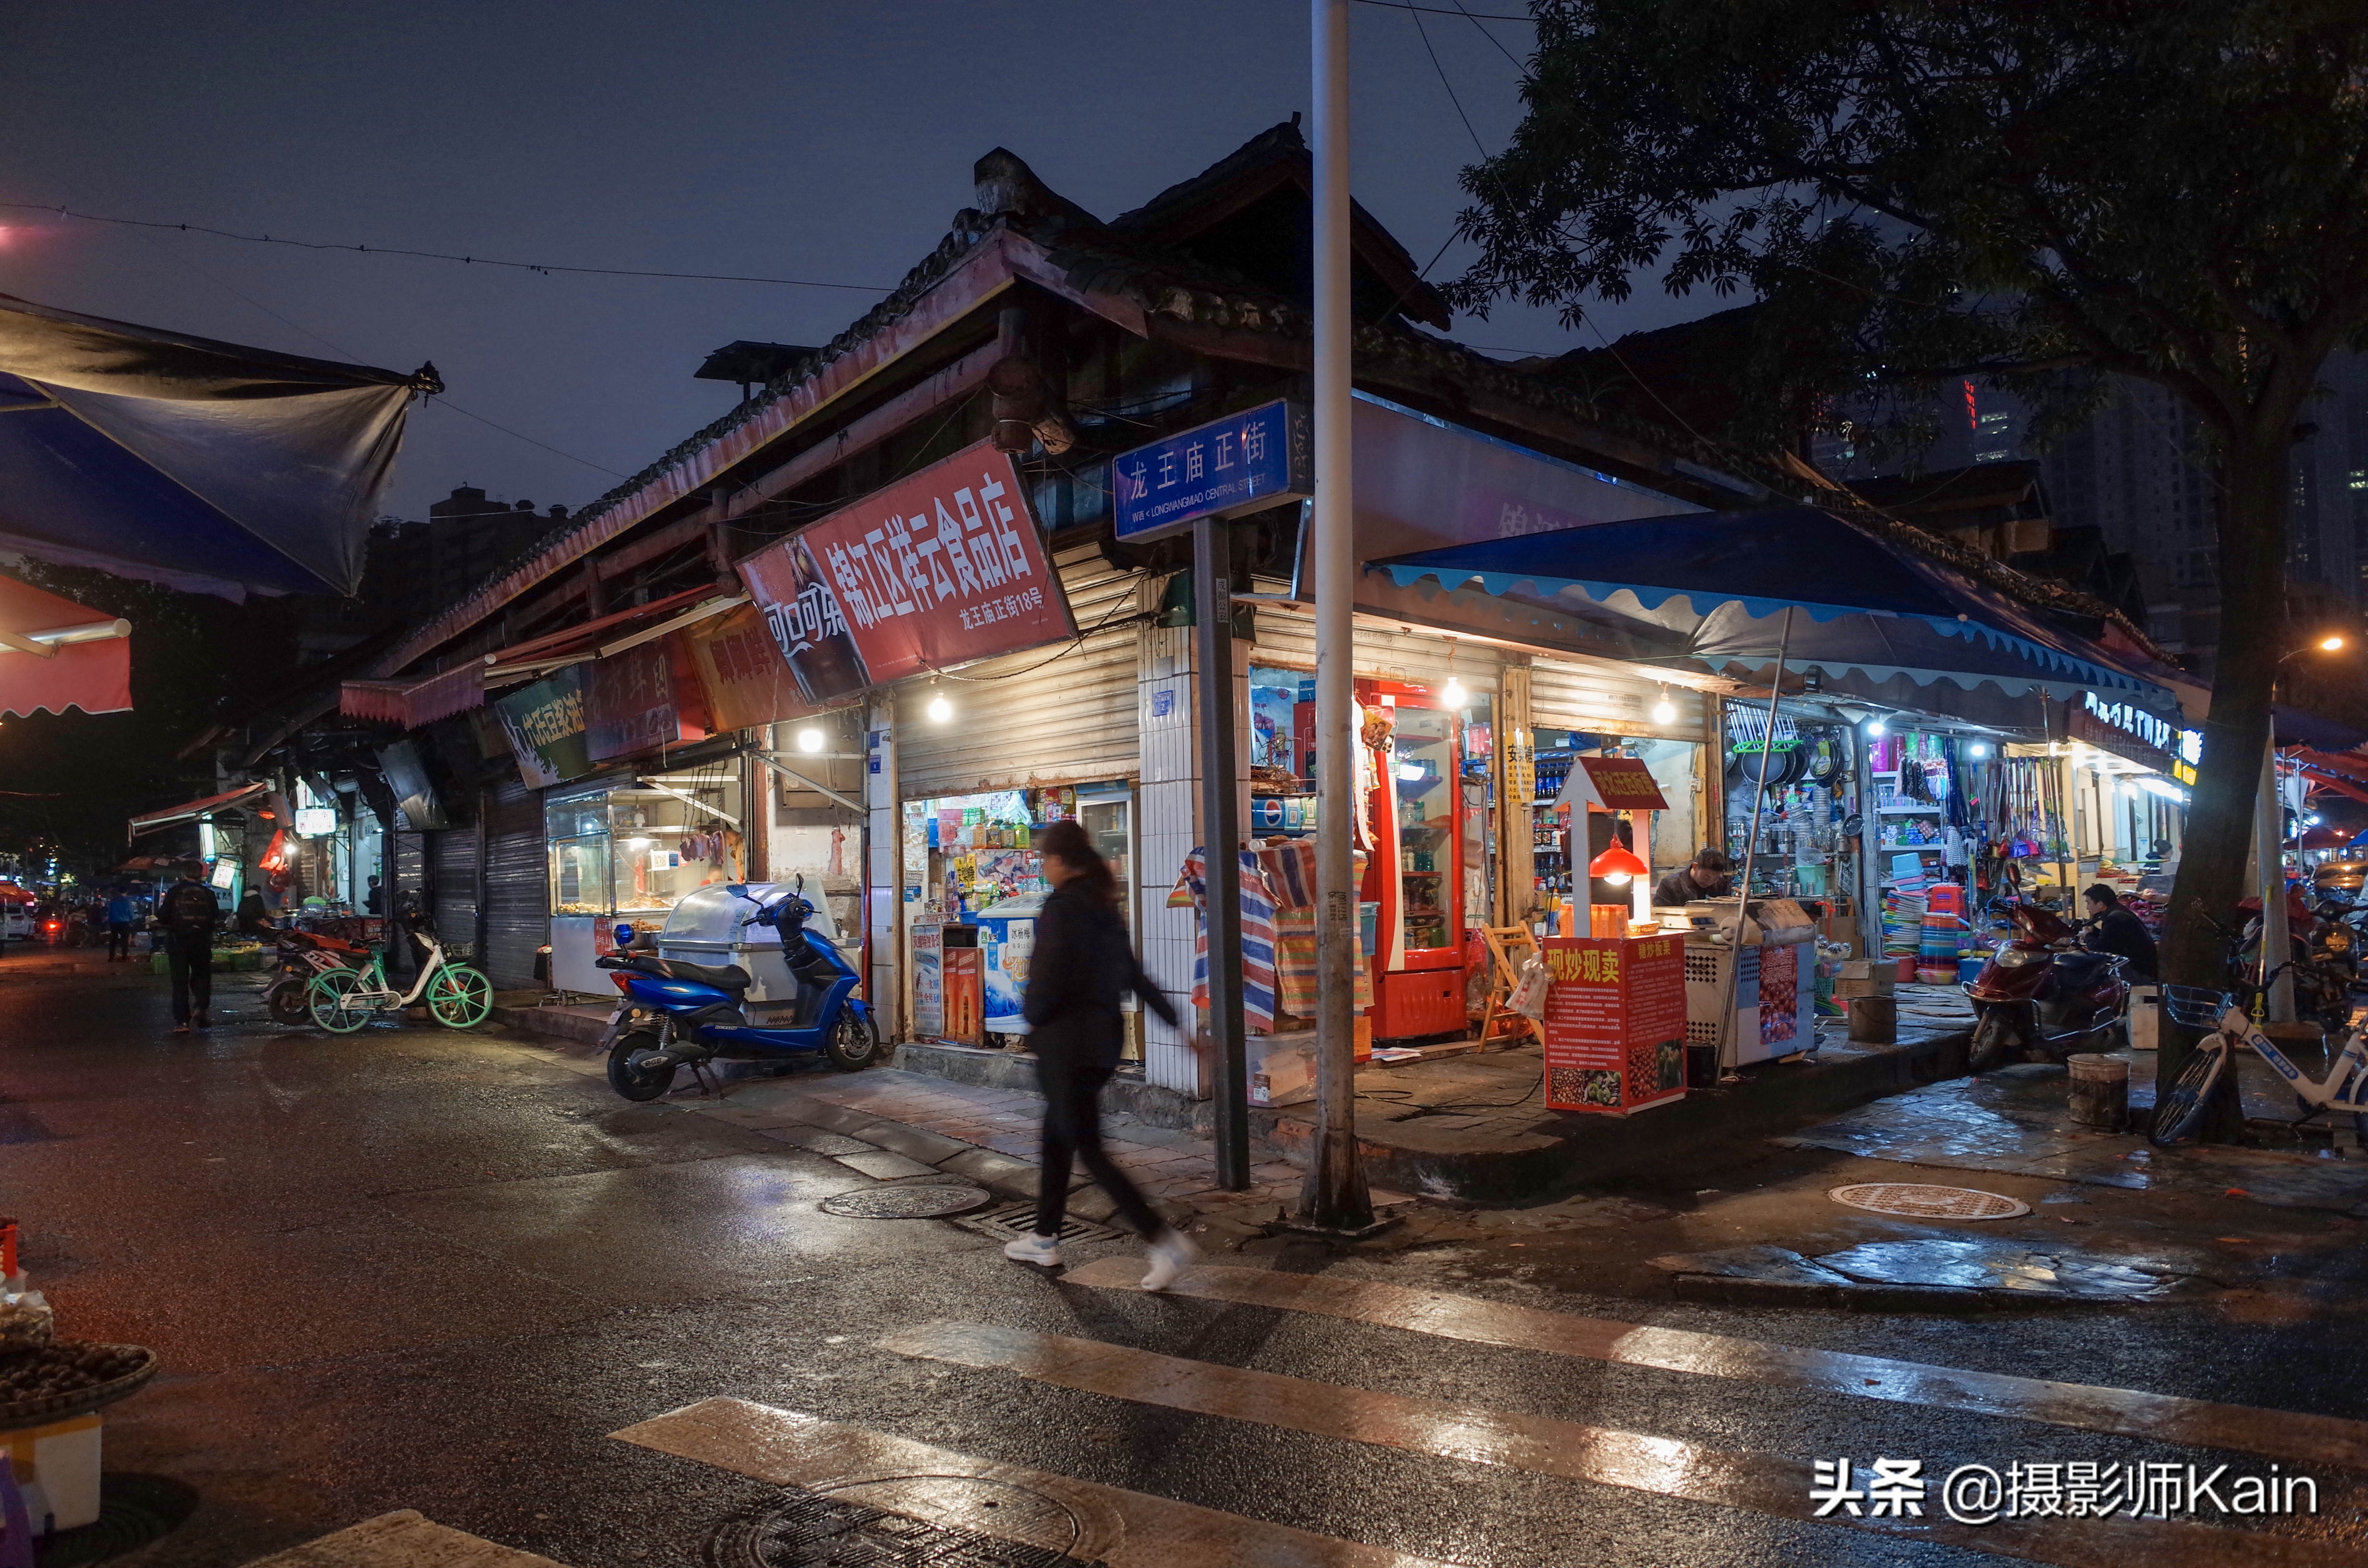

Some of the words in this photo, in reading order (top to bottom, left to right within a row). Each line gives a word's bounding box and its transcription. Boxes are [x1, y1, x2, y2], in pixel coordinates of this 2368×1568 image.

[1130, 421, 1265, 500] 龙王庙正街
[1151, 491, 1204, 518] LONGWANGMIAO
[1205, 482, 1237, 501] CENTRAL
[1238, 473, 1265, 490] STREET
[1499, 502, 1576, 539] 锦江
[824, 472, 1032, 631] 锦江区祥云食品店
[764, 581, 847, 657] 可口可乐
[959, 587, 1045, 631] 龙王庙正街18号
[1217, 580, 1227, 621] 成都公安
[1011, 927, 1031, 940] 冰杨梅
[1547, 948, 1619, 983] 现炒现卖
